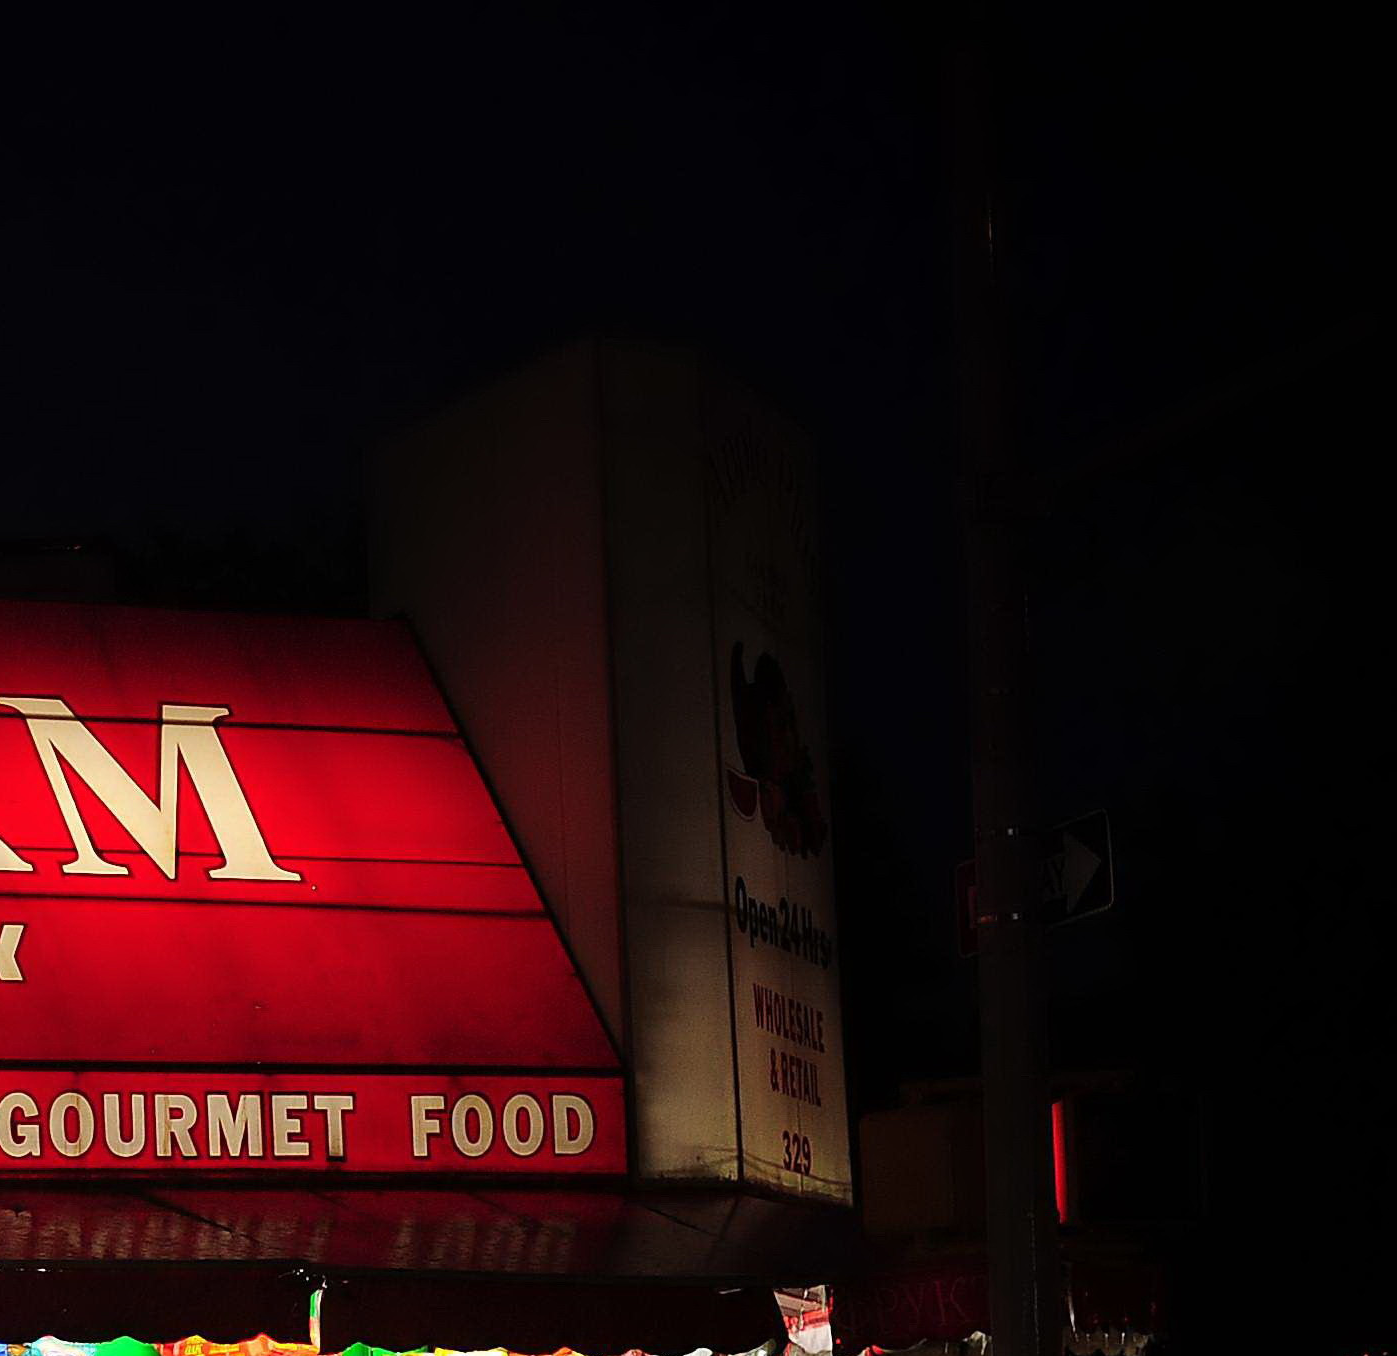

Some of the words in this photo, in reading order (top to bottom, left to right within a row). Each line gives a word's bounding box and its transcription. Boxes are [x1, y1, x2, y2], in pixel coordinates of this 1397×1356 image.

[735, 876, 778, 949] Open
[778, 896, 799, 954] 24
[753, 983, 825, 1054] WHOLESALE
[770, 1048, 781, 1093] &
[781, 1052, 822, 1107] RETAIL
[410, 1094, 594, 1158] FOOD
[782, 1131, 812, 1176] 329
